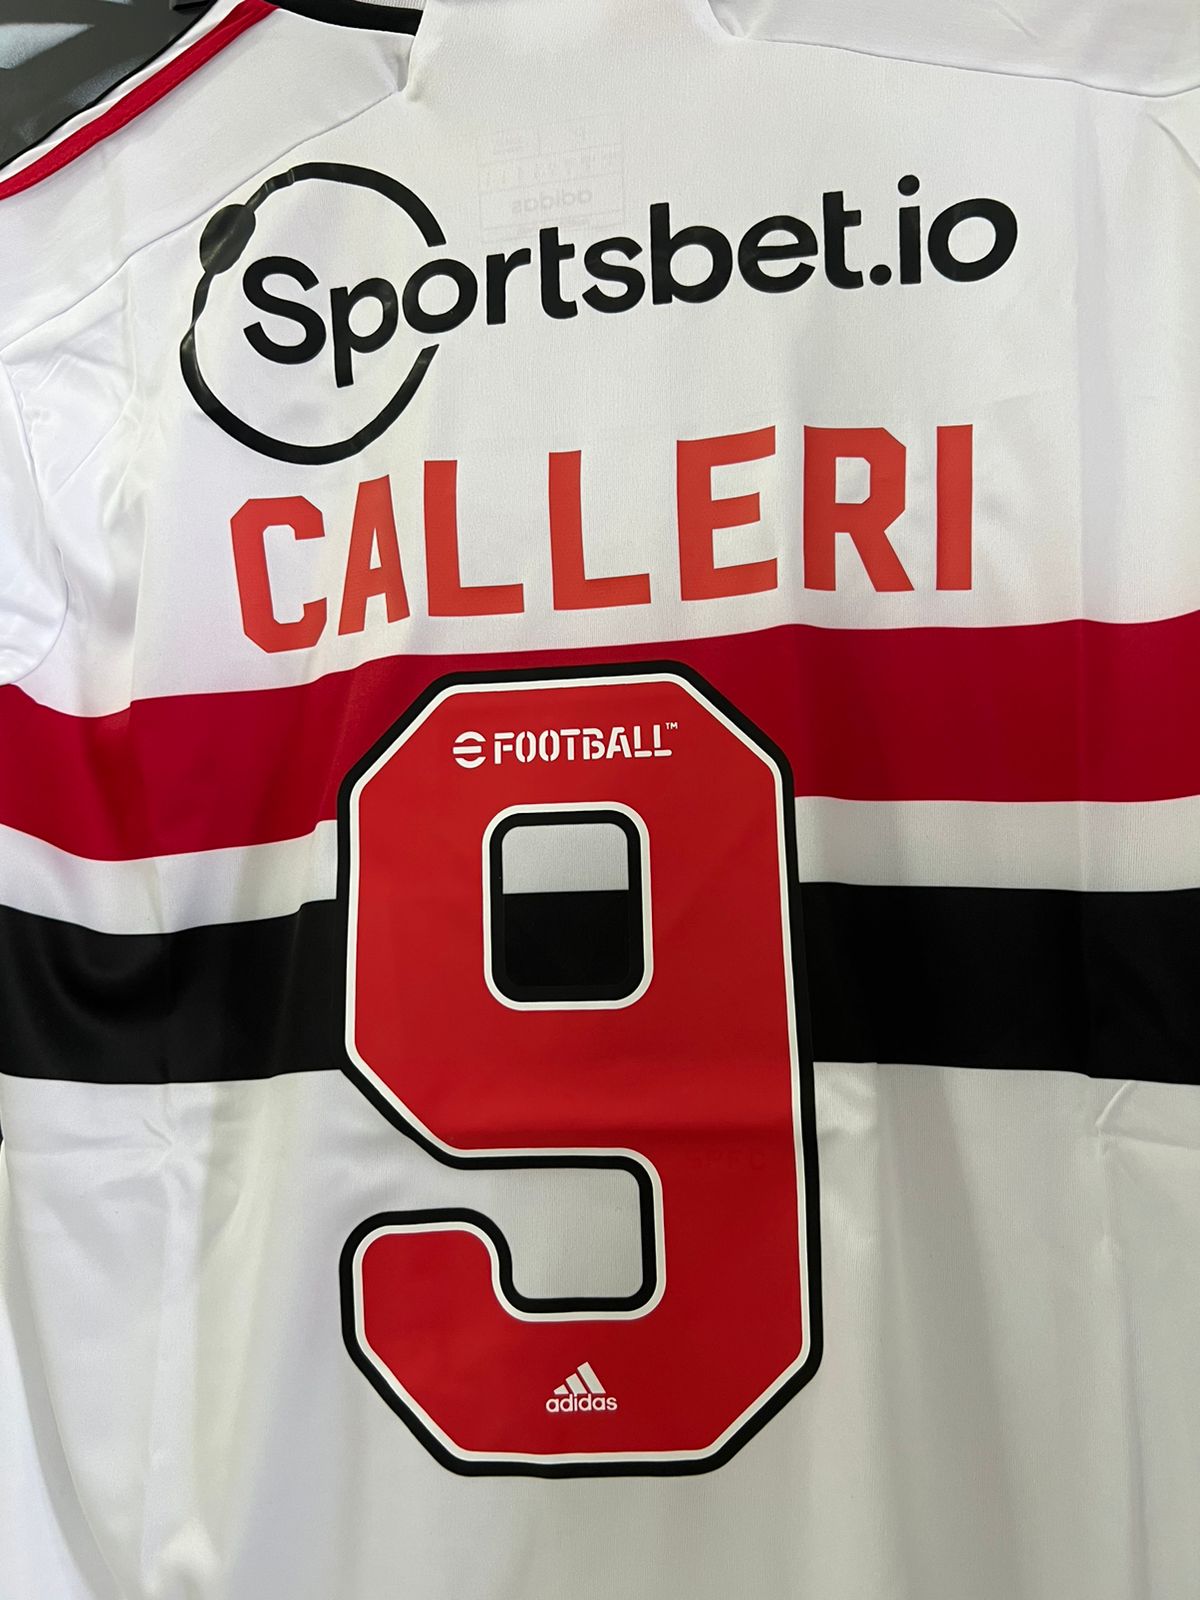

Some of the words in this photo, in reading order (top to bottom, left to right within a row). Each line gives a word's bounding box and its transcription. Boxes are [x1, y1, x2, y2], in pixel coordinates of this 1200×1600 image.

[243, 175, 1018, 388] Sportsbet.io
[230, 424, 973, 653] CALLERI
[338, 660, 823, 1479] 9
[545, 1393, 618, 1413] adidas
